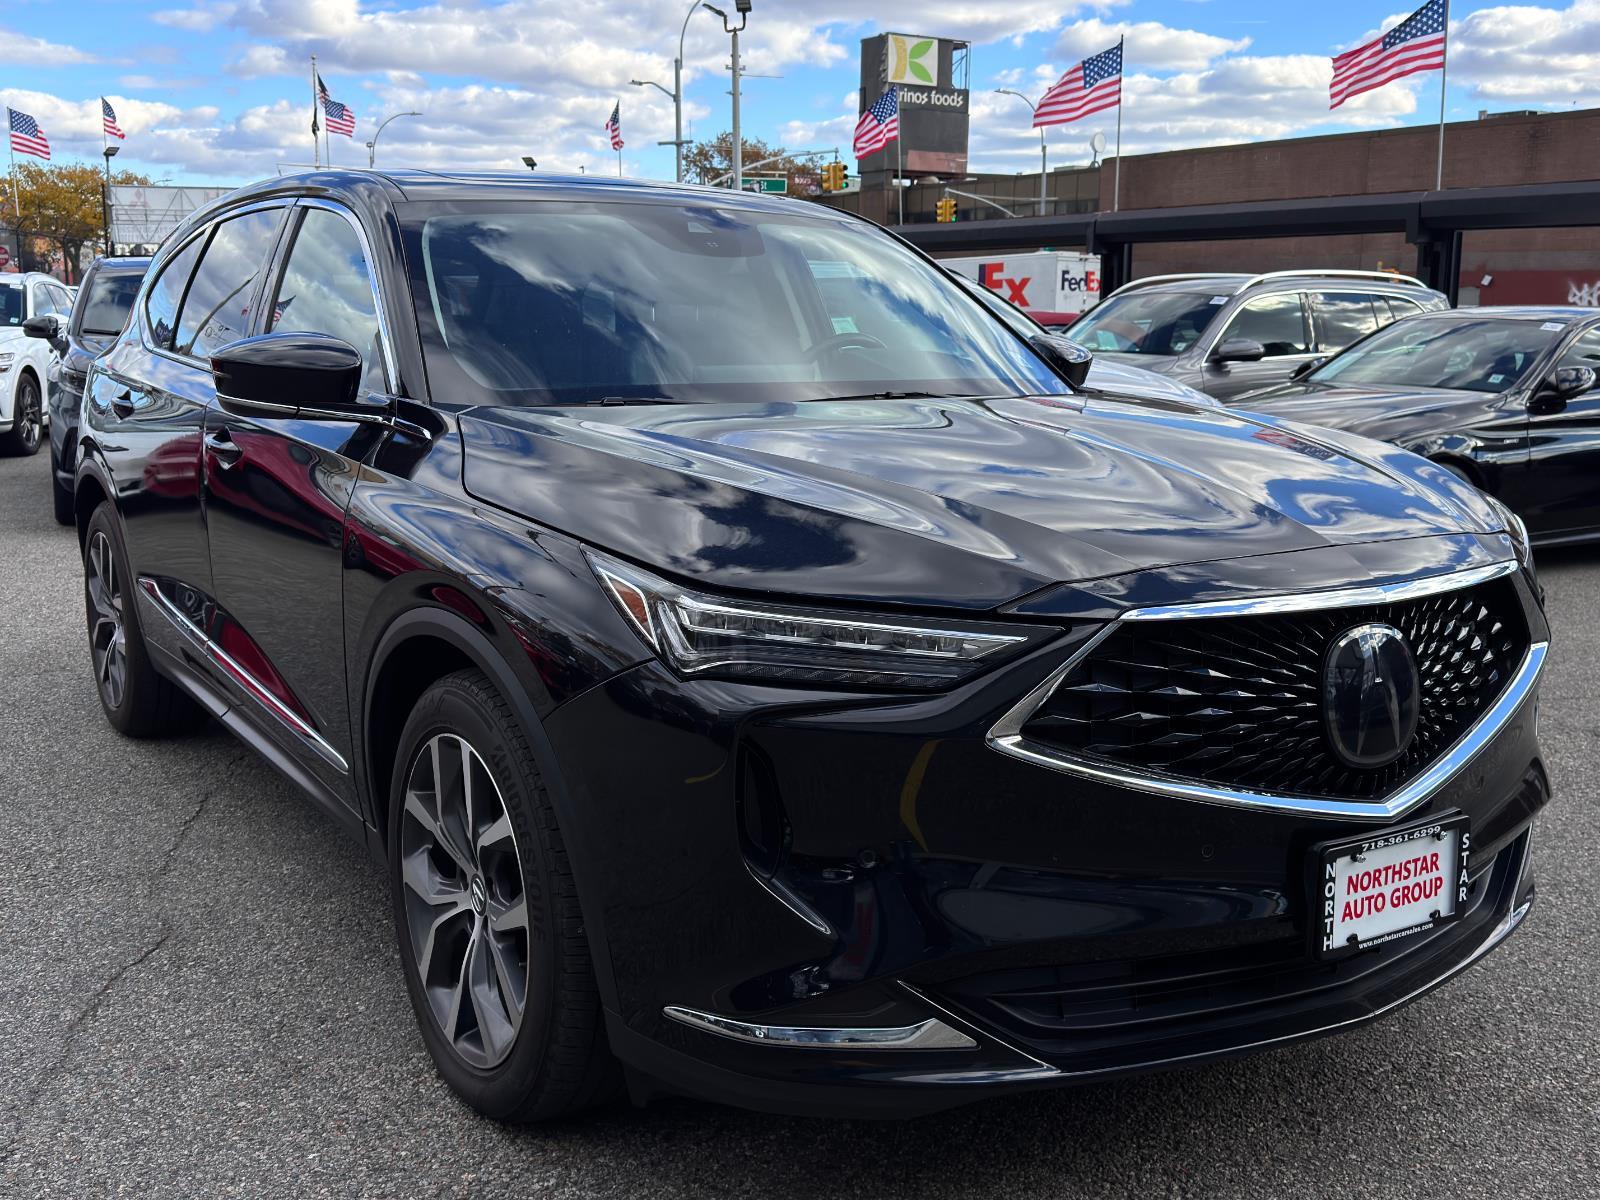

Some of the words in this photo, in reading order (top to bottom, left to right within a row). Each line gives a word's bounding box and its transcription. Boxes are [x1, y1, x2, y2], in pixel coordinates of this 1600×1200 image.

[899, 88, 928, 105] rinos
[931, 90, 964, 107] foods
[1362, 826, 1441, 851] 718-361-6299
[1347, 853, 1440, 895] NORTHSTAR
[1458, 833, 1470, 902] STAR
[1323, 863, 1335, 951] NORTH
[1341, 892, 1386, 923] AUTO
[1390, 876, 1443, 908] GROUP
[1359, 923, 1434, 950] www.northstarcarsales.com
